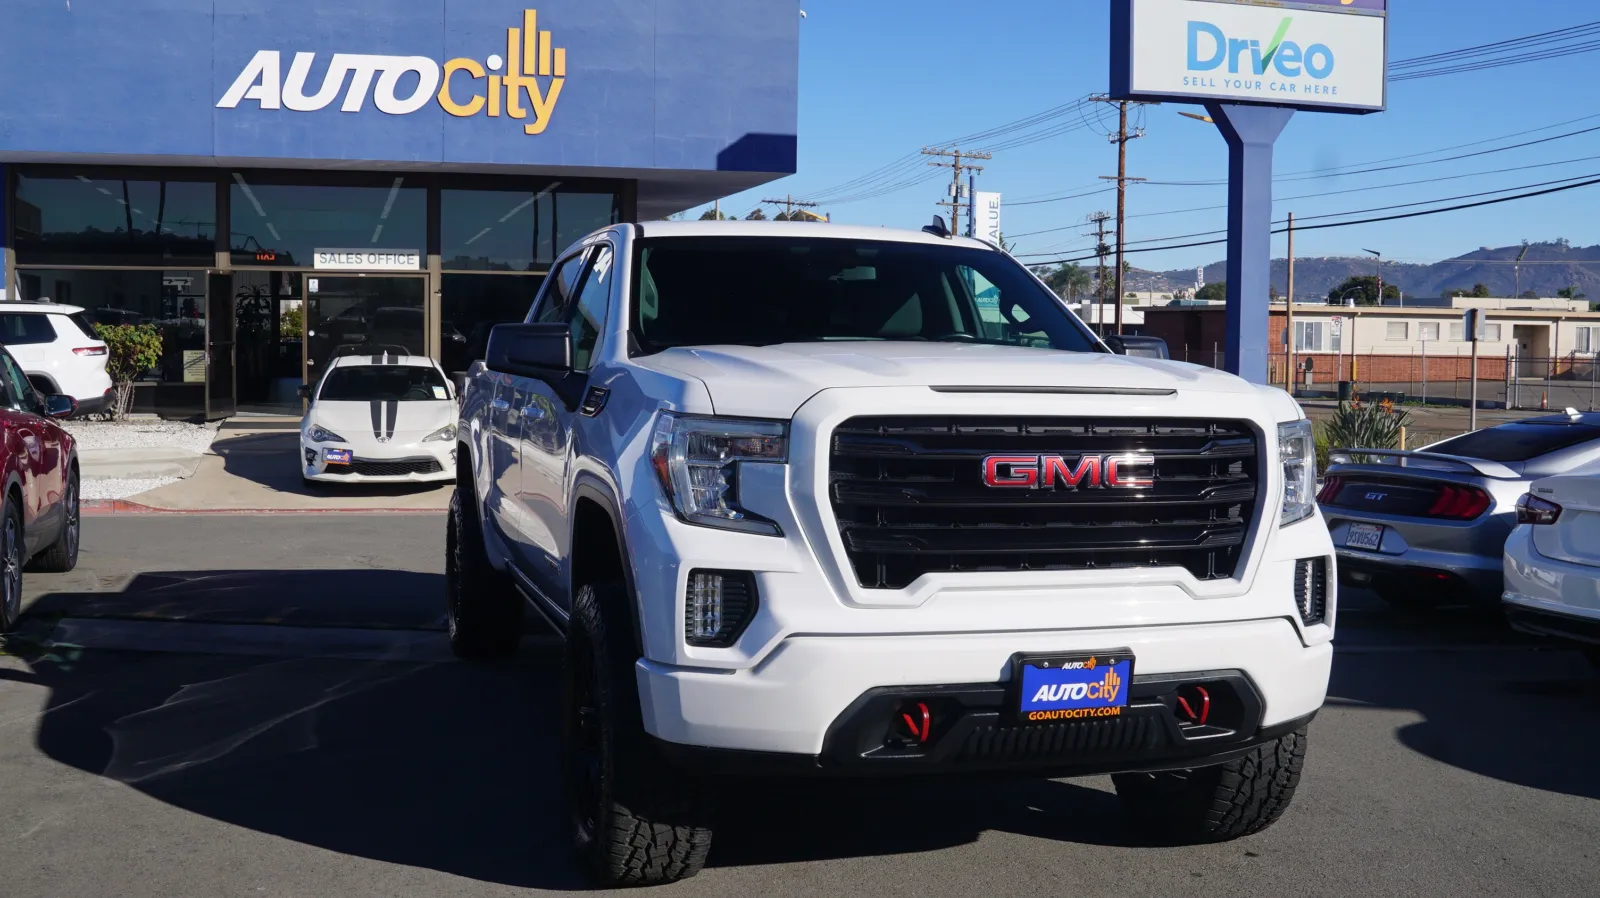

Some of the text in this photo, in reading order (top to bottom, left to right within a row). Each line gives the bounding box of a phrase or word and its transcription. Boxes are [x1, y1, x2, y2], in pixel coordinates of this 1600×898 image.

[1187, 17, 1335, 79] Driveo
[1183, 76, 1338, 95] SELL YOUR CAR HERE
[319, 252, 415, 265] SALES OFFICE
[982, 455, 1155, 489] GMC
[1028, 707, 1121, 720] GOAUTOCITY.COM
